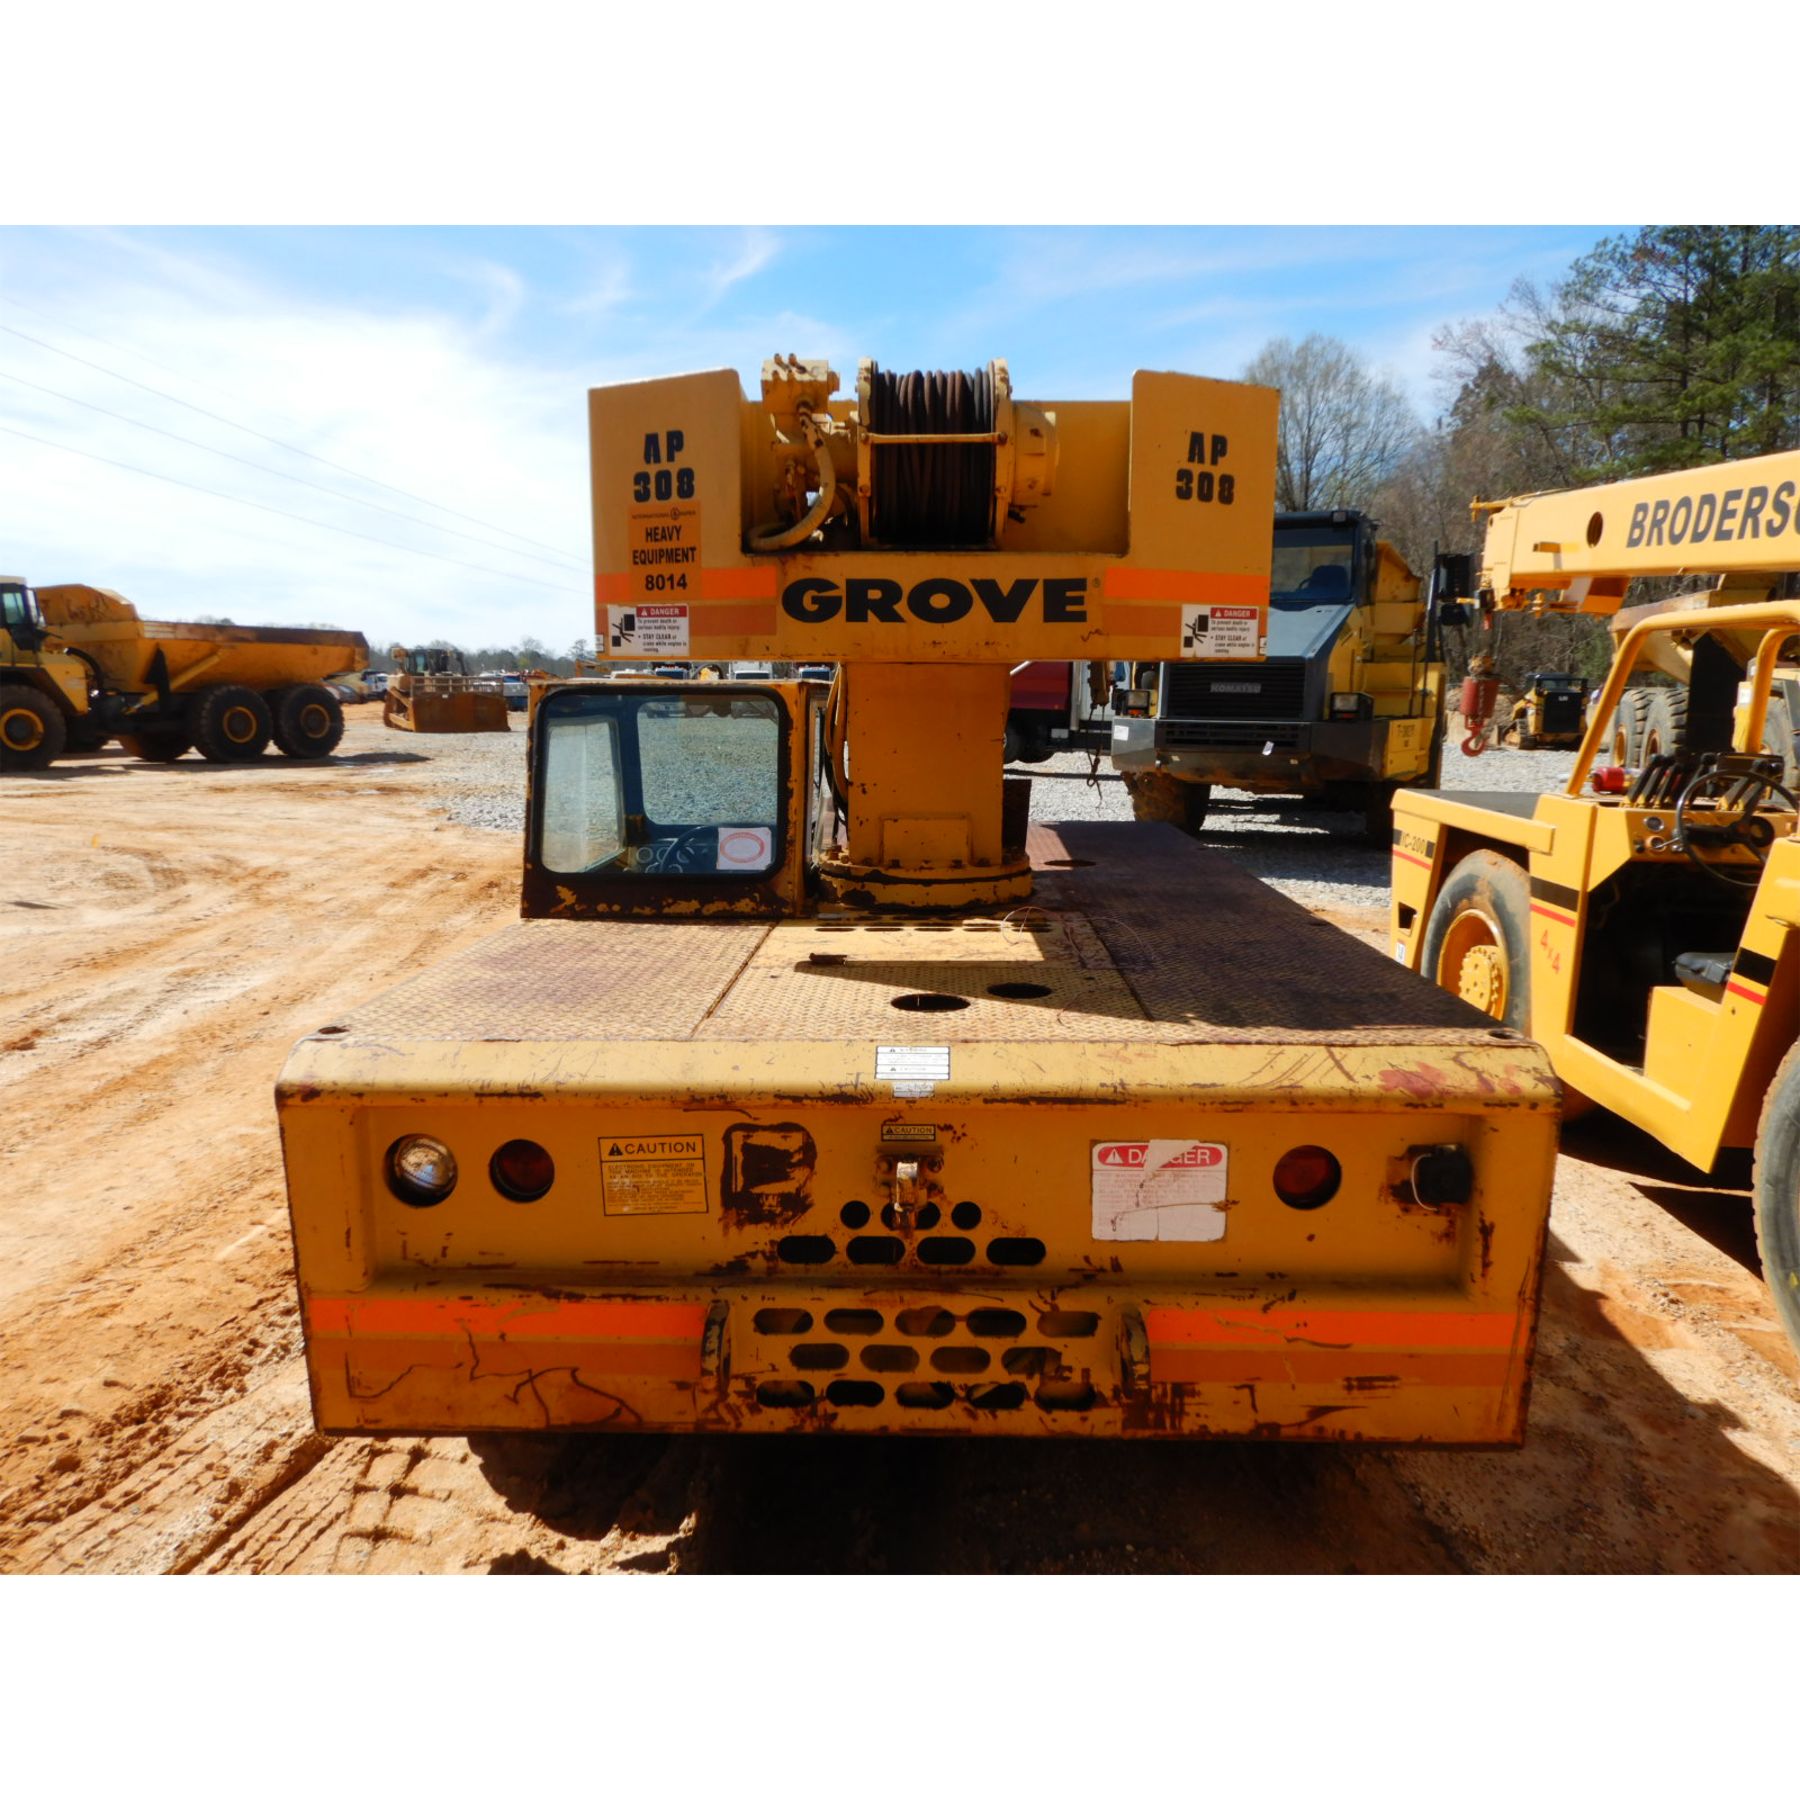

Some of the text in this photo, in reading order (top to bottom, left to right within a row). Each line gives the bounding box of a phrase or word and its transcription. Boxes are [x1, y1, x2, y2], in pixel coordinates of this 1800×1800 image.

[643, 430, 684, 464] AP
[1188, 431, 1228, 466] AP
[633, 467, 695, 503] 308
[1175, 468, 1235, 505] 308
[1625, 481, 1800, 548] BRODERS
[645, 525, 682, 543] HEAVY
[632, 545, 697, 566] EQUIPMENT
[645, 573, 688, 591] 8014
[781, 577, 1088, 624] GROVE
[650, 607, 680, 616] DANGER
[1223, 609, 1251, 618] DANGER
[894, 1126, 932, 1134] CAUTION
[624, 1141, 697, 1155] CAUTION
